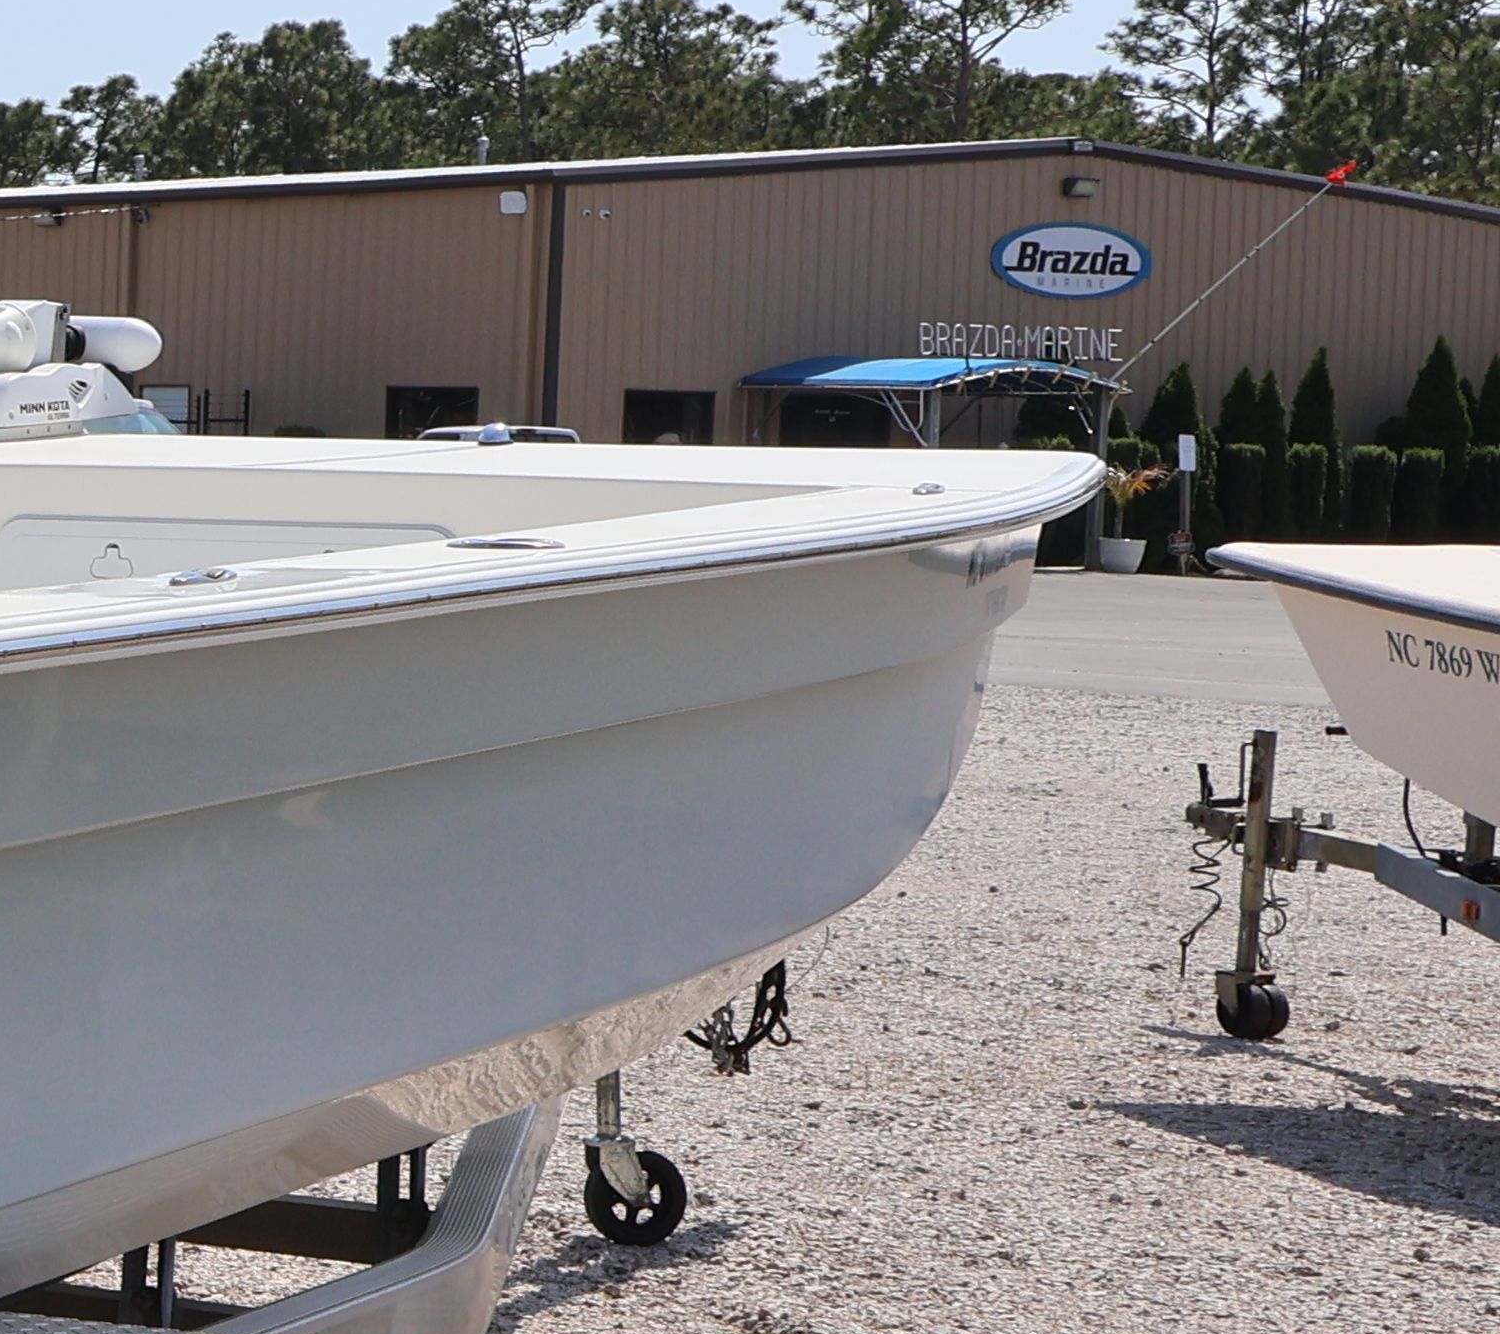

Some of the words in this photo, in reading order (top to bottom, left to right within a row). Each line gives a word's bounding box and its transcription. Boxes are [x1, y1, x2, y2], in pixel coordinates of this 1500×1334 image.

[1005, 241, 1137, 276] Brazda
[1037, 276, 1105, 289] MARINE
[919, 322, 1015, 358] BRAZDA
[1024, 326, 1123, 362] MARINE
[19, 403, 46, 414] MINN
[47, 400, 70, 412] KOTA
[1385, 630, 1419, 667] NC
[1424, 639, 1472, 678] 7869
